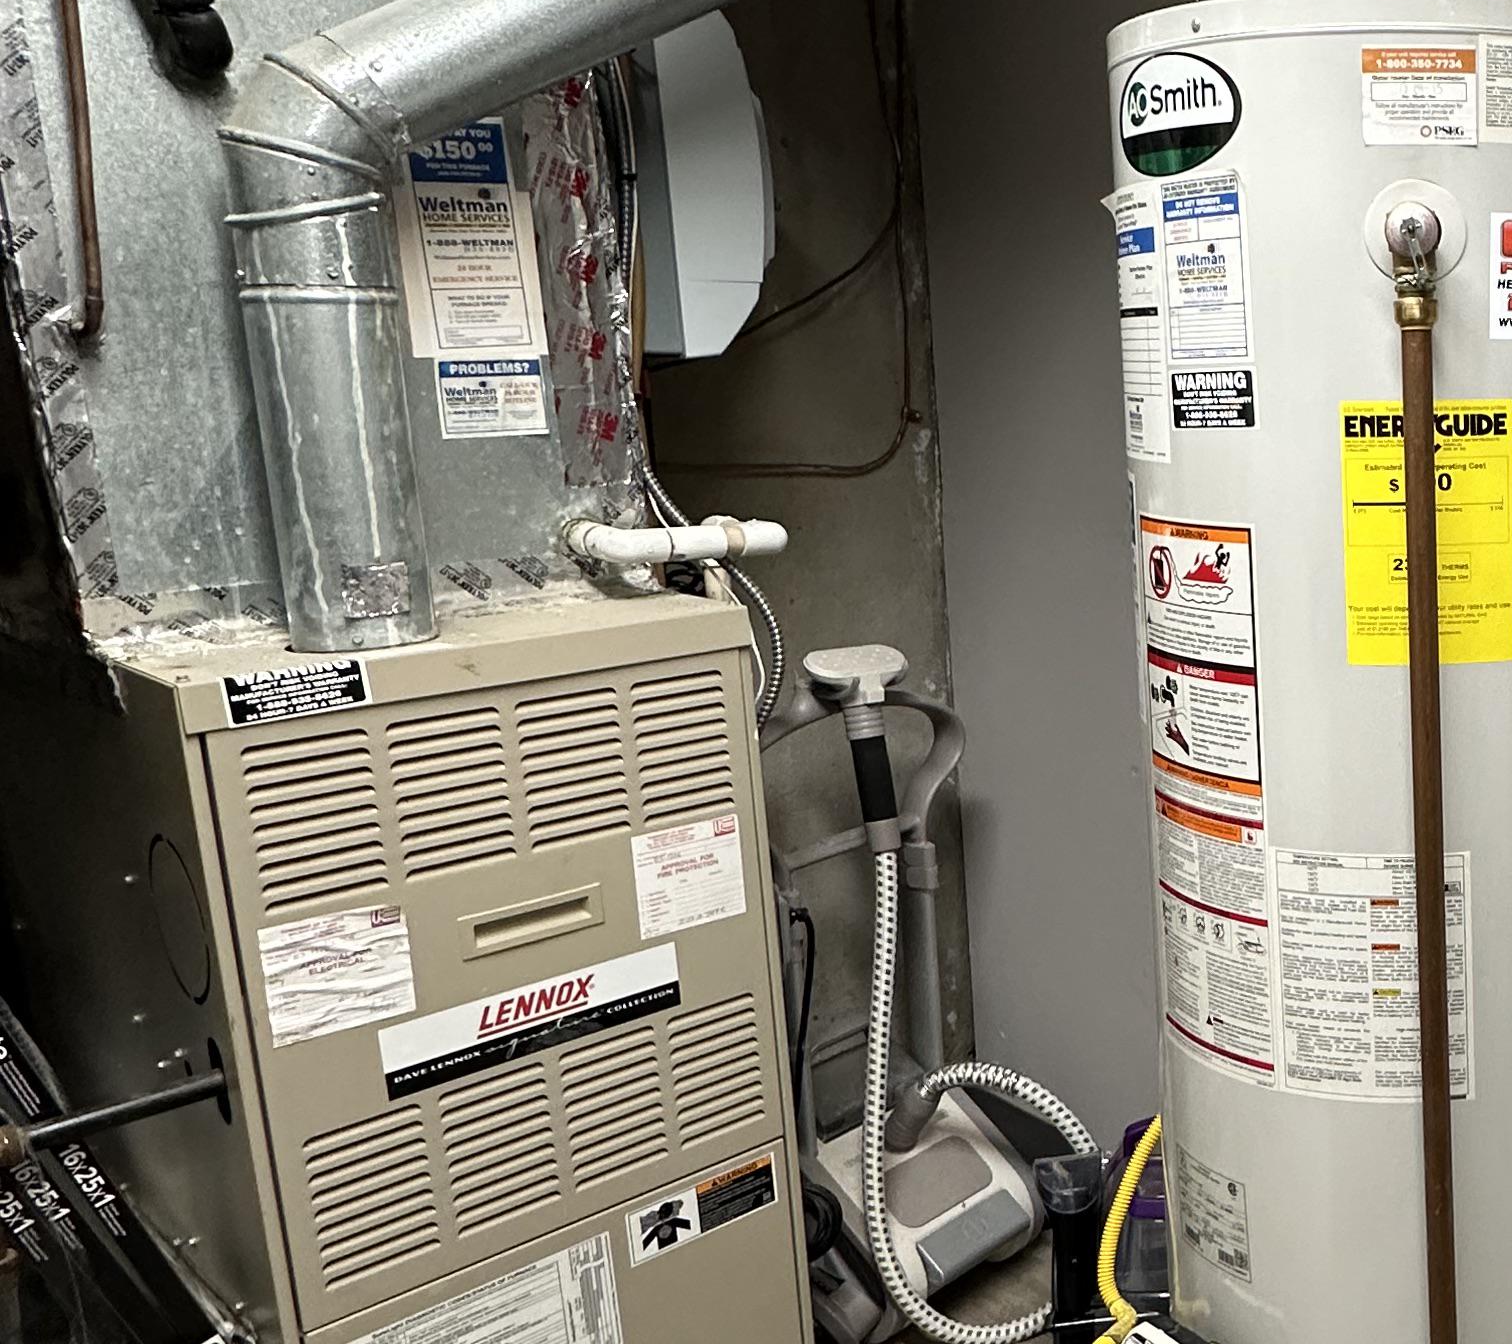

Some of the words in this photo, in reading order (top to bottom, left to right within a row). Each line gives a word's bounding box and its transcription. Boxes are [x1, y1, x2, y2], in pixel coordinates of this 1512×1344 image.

[1150, 76, 1217, 115] Smith
[469, 128, 491, 138] YOU
[420, 140, 476, 160] $150
[477, 142, 494, 153] 00
[418, 196, 508, 213] Weltman
[423, 213, 459, 223] HOME
[461, 213, 511, 223] SERVICES
[426, 239, 514, 247] 1-888-WELTMAN
[1177, 253, 1225, 268] Weltman
[449, 362, 530, 375] PROBLEMS?
[1174, 371, 1247, 391] WARNING
[444, 387, 497, 397] Weltman
[1344, 413, 1507, 438] ENERGUIDE
[1364, 463, 1403, 471] Estimated
[1434, 462, 1467, 472] perating
[1468, 462, 1487, 470] Cost
[232, 659, 352, 687] WARNING
[1184, 664, 1215, 680] DANGER
[230, 682, 311, 702] MANUFACTURER'S
[313, 674, 360, 687] WARRANTY
[661, 857, 697, 871] APPROVAL
[700, 853, 714, 862] FOR
[675, 859, 719, 875] PROTECTION
[300, 952, 350, 970] APPROVAL
[309, 957, 365, 976] ELECTRICAL
[479, 973, 595, 1032] LENNOX
[394, 1068, 428, 1084] DAVE
[430, 1050, 482, 1075] LENNOX
[606, 987, 675, 1014] COLLECTION
[58, 1143, 116, 1208] 16x25x1
[719, 1161, 758, 1184] WARNING
[11, 1158, 71, 1223] 16x25x1
[0, 1189, 35, 1235] 25x1
